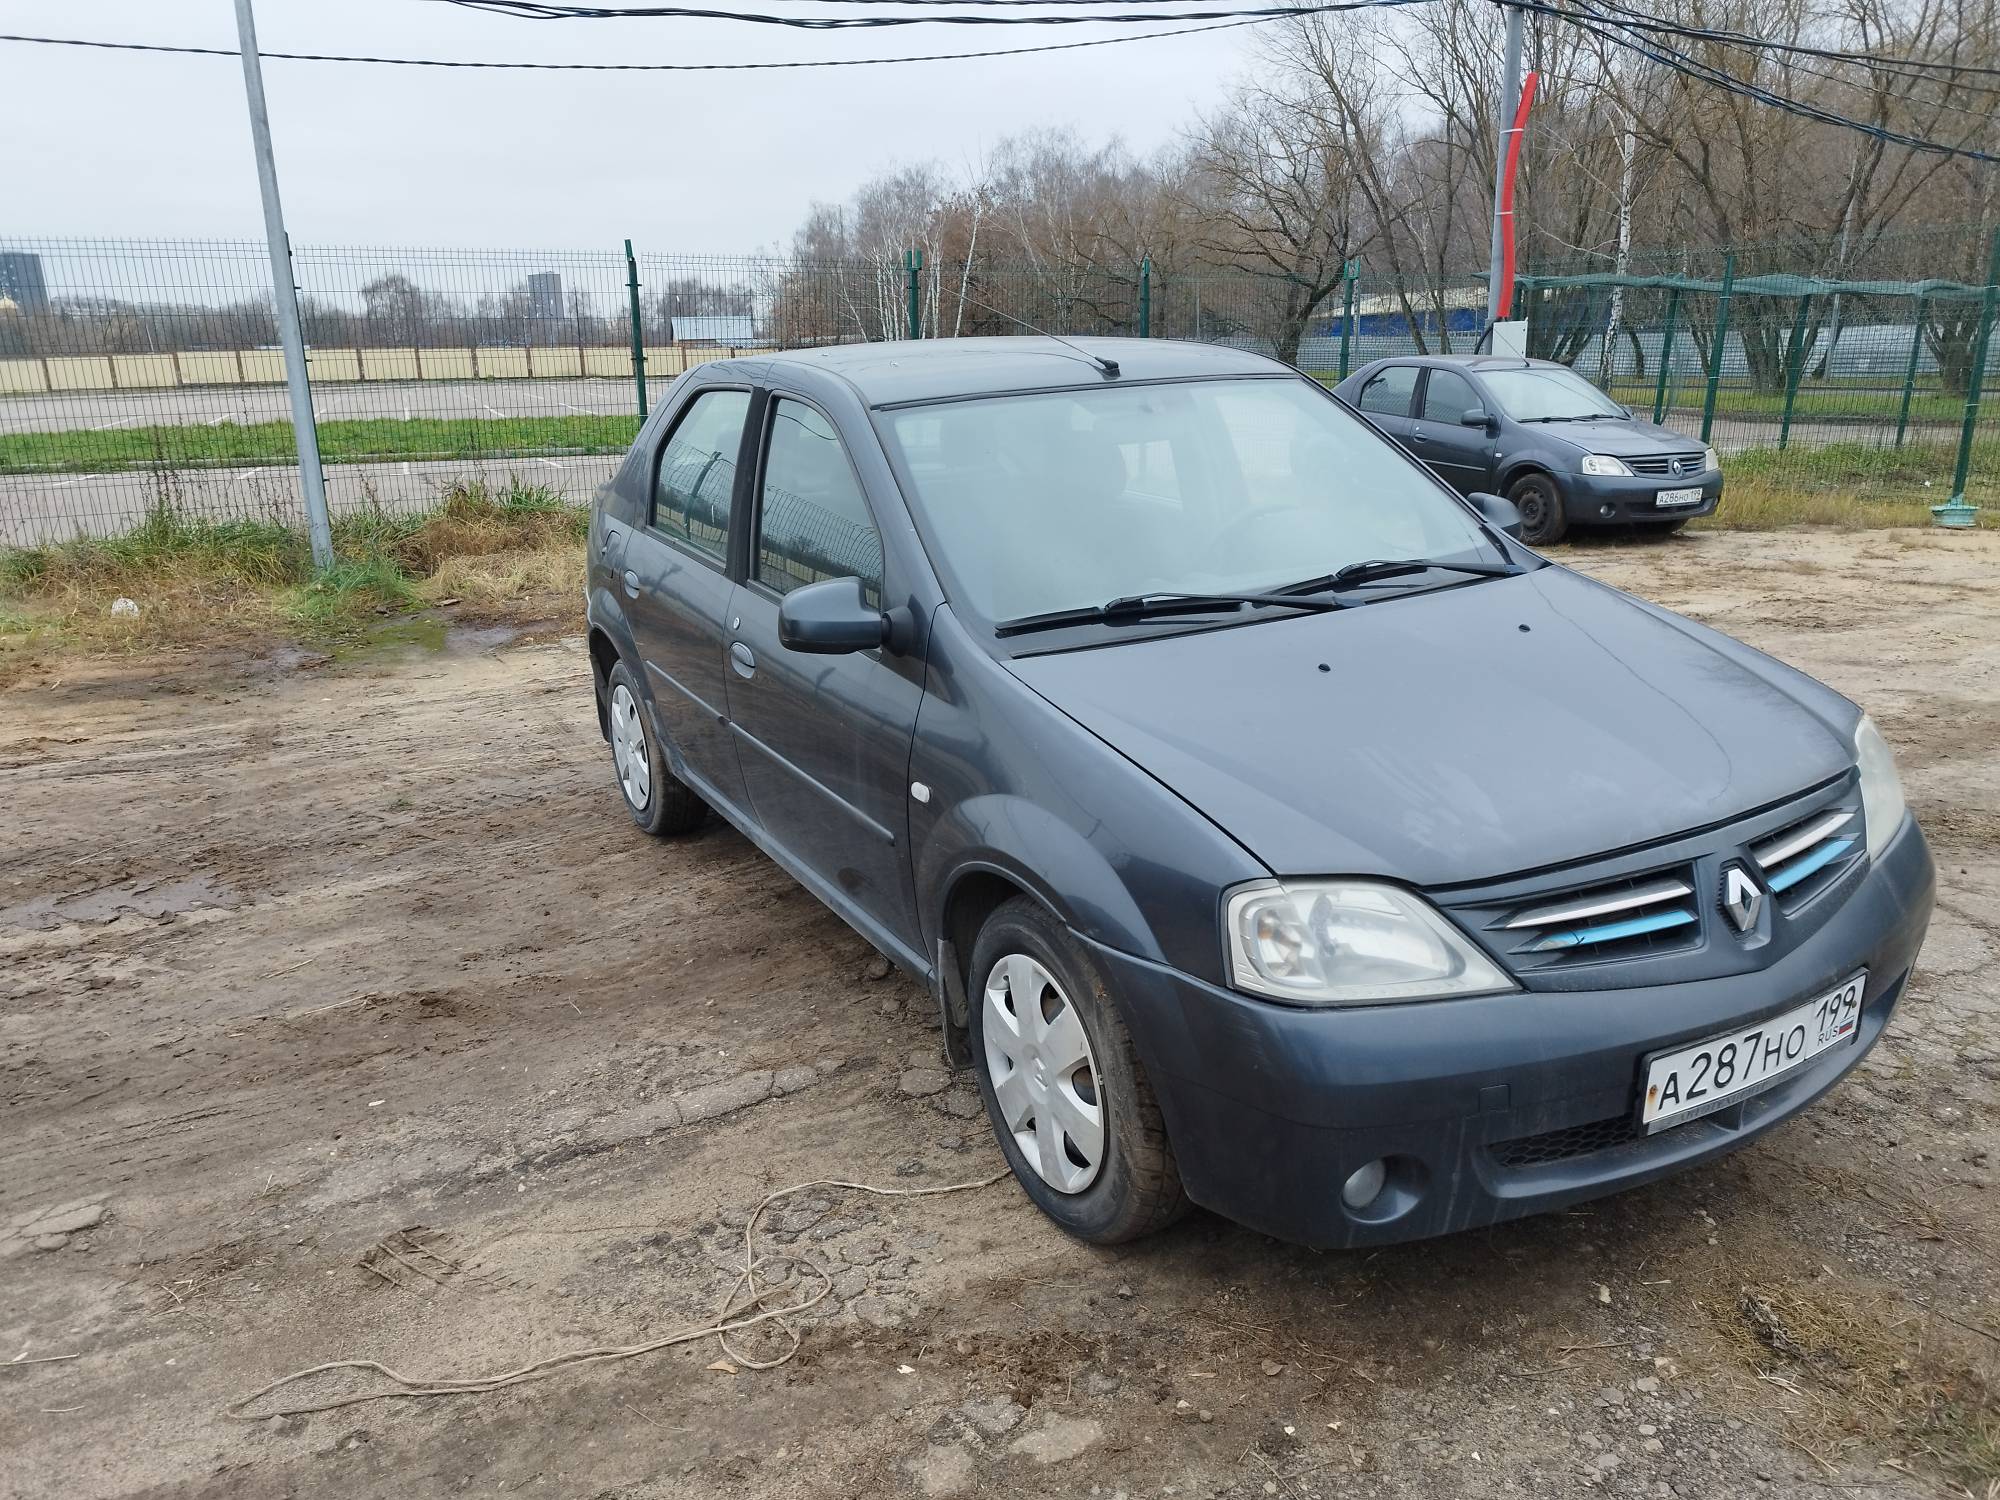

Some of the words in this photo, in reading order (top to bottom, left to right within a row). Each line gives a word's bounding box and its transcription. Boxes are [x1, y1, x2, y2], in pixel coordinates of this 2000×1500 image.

[1658, 1025, 1805, 1111] А287НО
[1816, 986, 1856, 1031] 199
[1818, 1026, 1839, 1046] RUS
